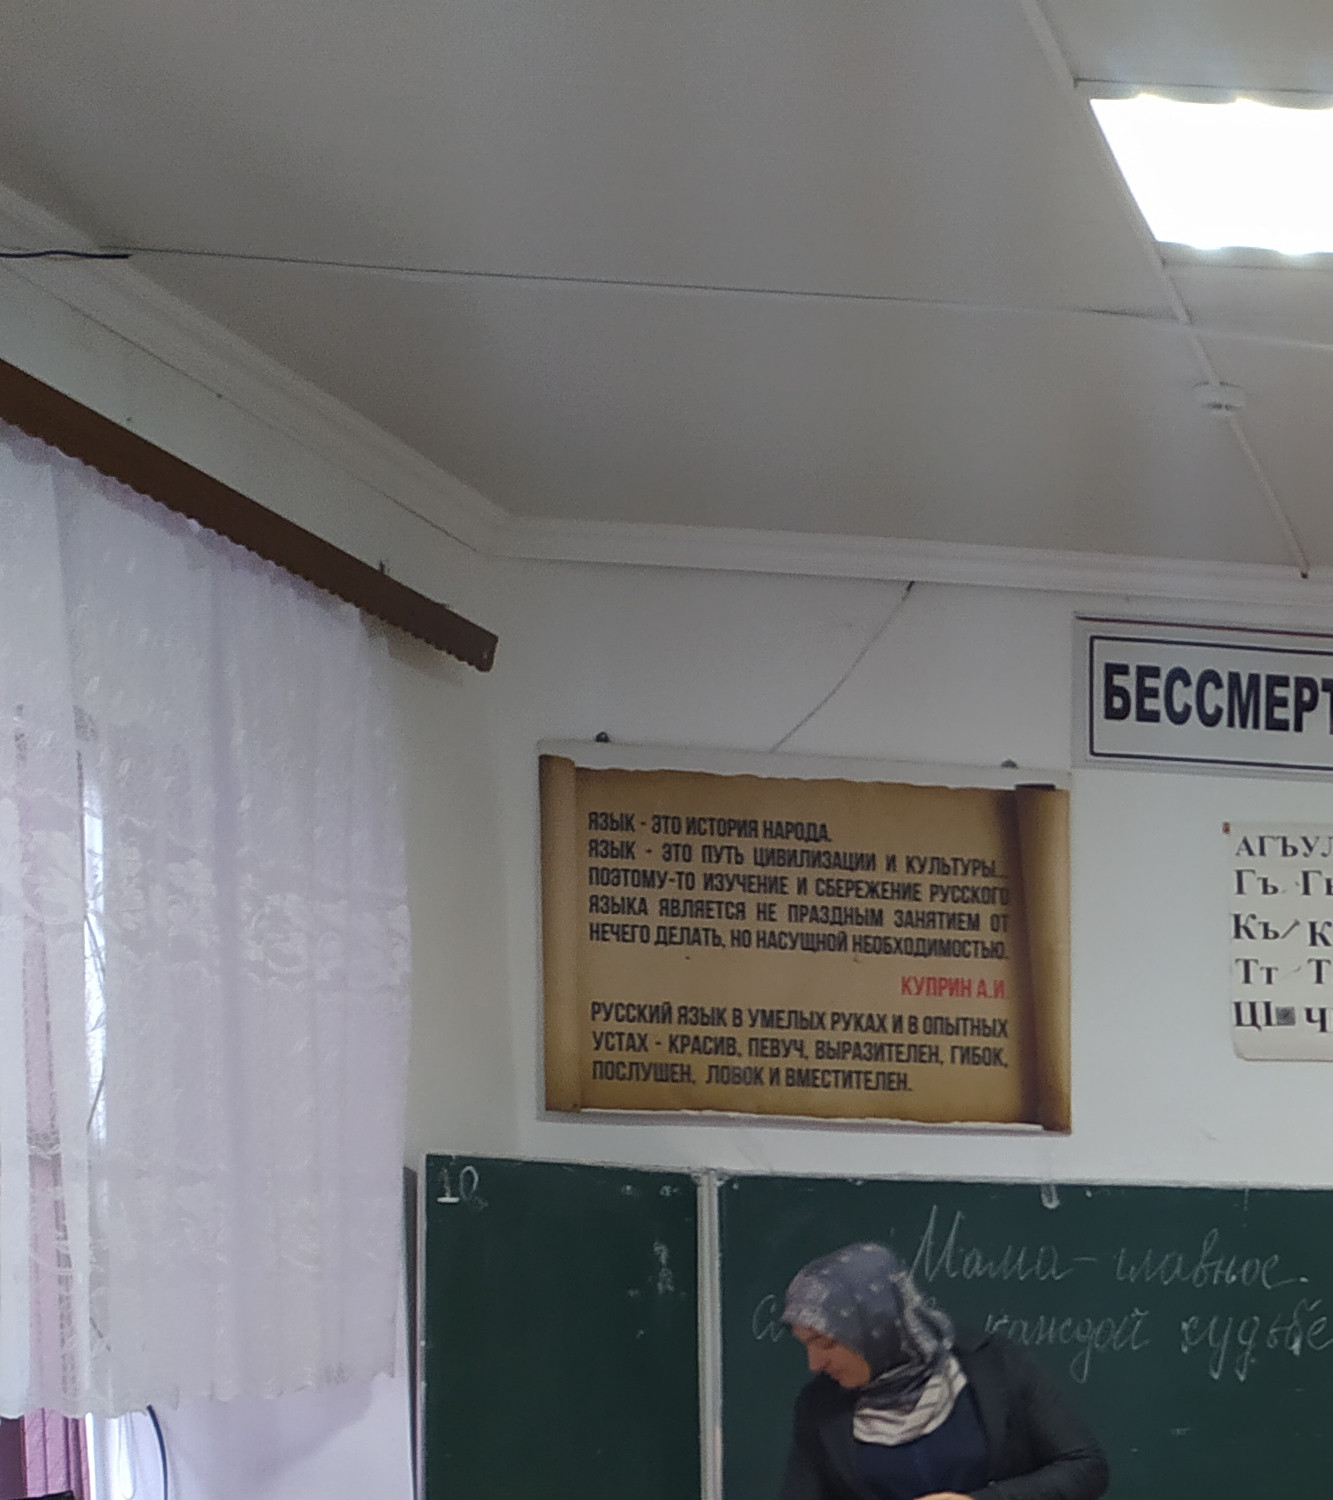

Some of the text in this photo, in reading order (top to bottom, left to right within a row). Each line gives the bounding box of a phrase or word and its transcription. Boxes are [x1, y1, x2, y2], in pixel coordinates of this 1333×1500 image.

[589, 812, 832, 842] ЯЗЫК ЭТО ИСТОРИЯ НАРОДА.
[589, 839, 635, 859] ЯЗЫК
[662, 843, 692, 863] ЭТО
[702, 845, 744, 865] ПУТЬ
[753, 847, 876, 872] ЦИВИЛИЗАЦИИ
[886, 854, 896, 872] И
[589, 867, 1009, 905] ПОЭТОМУ-ТО ИЗУЧЕНИЕ И СБЕРЕЖЕНИЕ РУССКОГО
[589, 895, 1008, 932] ЯЗЫКА ЯВЛЯЕТСЯ НЕ ПРАЗДНЫМ ЗАНЯТИЕМ ОТ
[589, 923, 649, 942] НЕЧЕГО
[654, 926, 725, 948] ДЕЛАТЬ,
[730, 929, 751, 948] НО
[756, 931, 848, 953] НАСУЩНОЙ
[901, 976, 971, 996] КУПРИН
[1235, 958, 1278, 985] Тт
[591, 1001, 1008, 1038] РУССКИЙ ЯЗЫК В УМЕЛЫХ РУКАХ И В ОПЫТНЫХ
[593, 1031, 1008, 1067] УСТАХ КРАСИВ, ПЕВУЧ, ВЫРАЗИТЕЛЕН, ГИБОК,
[592, 1061, 913, 1091] ПОСЛУШЕН, ЛОВОК И ВМЕСТИТЕЛЕН.
